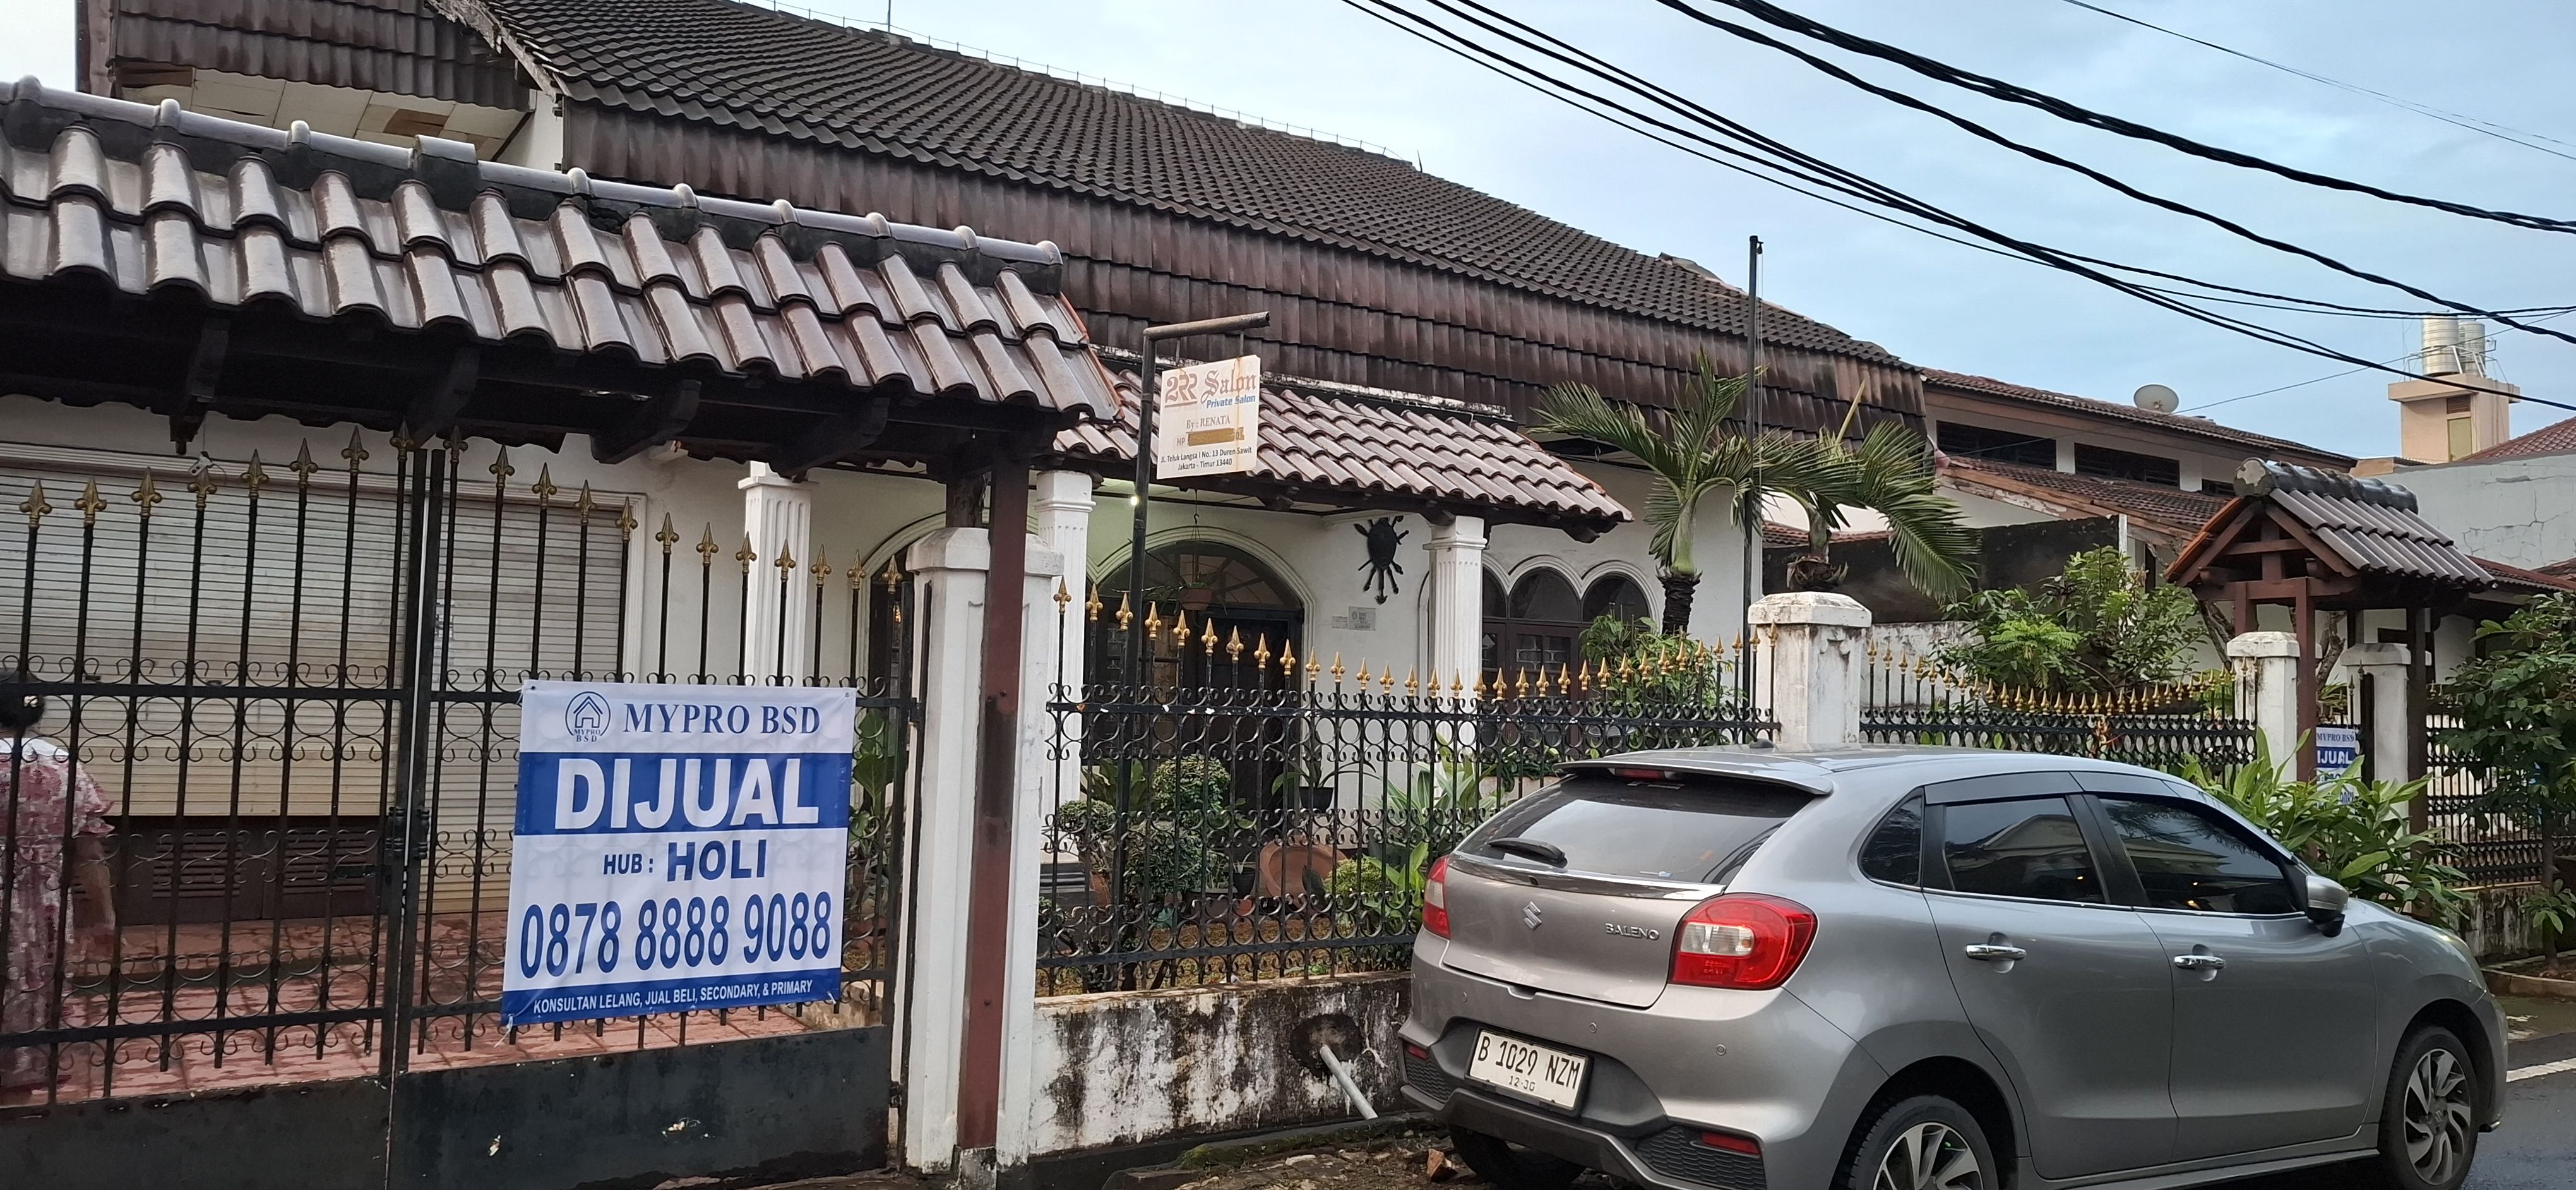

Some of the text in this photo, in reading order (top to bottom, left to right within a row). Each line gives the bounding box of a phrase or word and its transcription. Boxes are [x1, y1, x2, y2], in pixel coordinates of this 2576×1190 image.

[1201, 369, 1257, 404] Salon
[1207, 395, 1256, 409] Private Salon
[1186, 419, 1195, 431] By
[1200, 415, 1231, 427] RENATA
[1177, 438, 1185, 446] HP
[1167, 454, 1180, 463] Teluk
[1181, 452, 1198, 462] Langsa
[1202, 450, 1211, 459] No.
[1236, 446, 1252, 455] Sawit
[1178, 462, 1196, 471] Jakarta
[1216, 458, 1232, 466] 13440
[623, 702, 820, 735] MYPRO BSD
[2317, 733, 2340, 742] MYPRO
[2317, 750, 2353, 764] IJUAL
[554, 758, 820, 829] DIJUAL
[603, 853, 643, 875] HUB
[667, 839, 767, 882] HOLI
[520, 891, 832, 979] 0878 8888 9088
[1605, 922, 1659, 941] BALENO
[533, 980, 813, 1014] KONSULTAN LELANG, JUAL BELI, SECONDARY, & PRIMARY
[1477, 1035, 1581, 1090] B 1029 NZM
